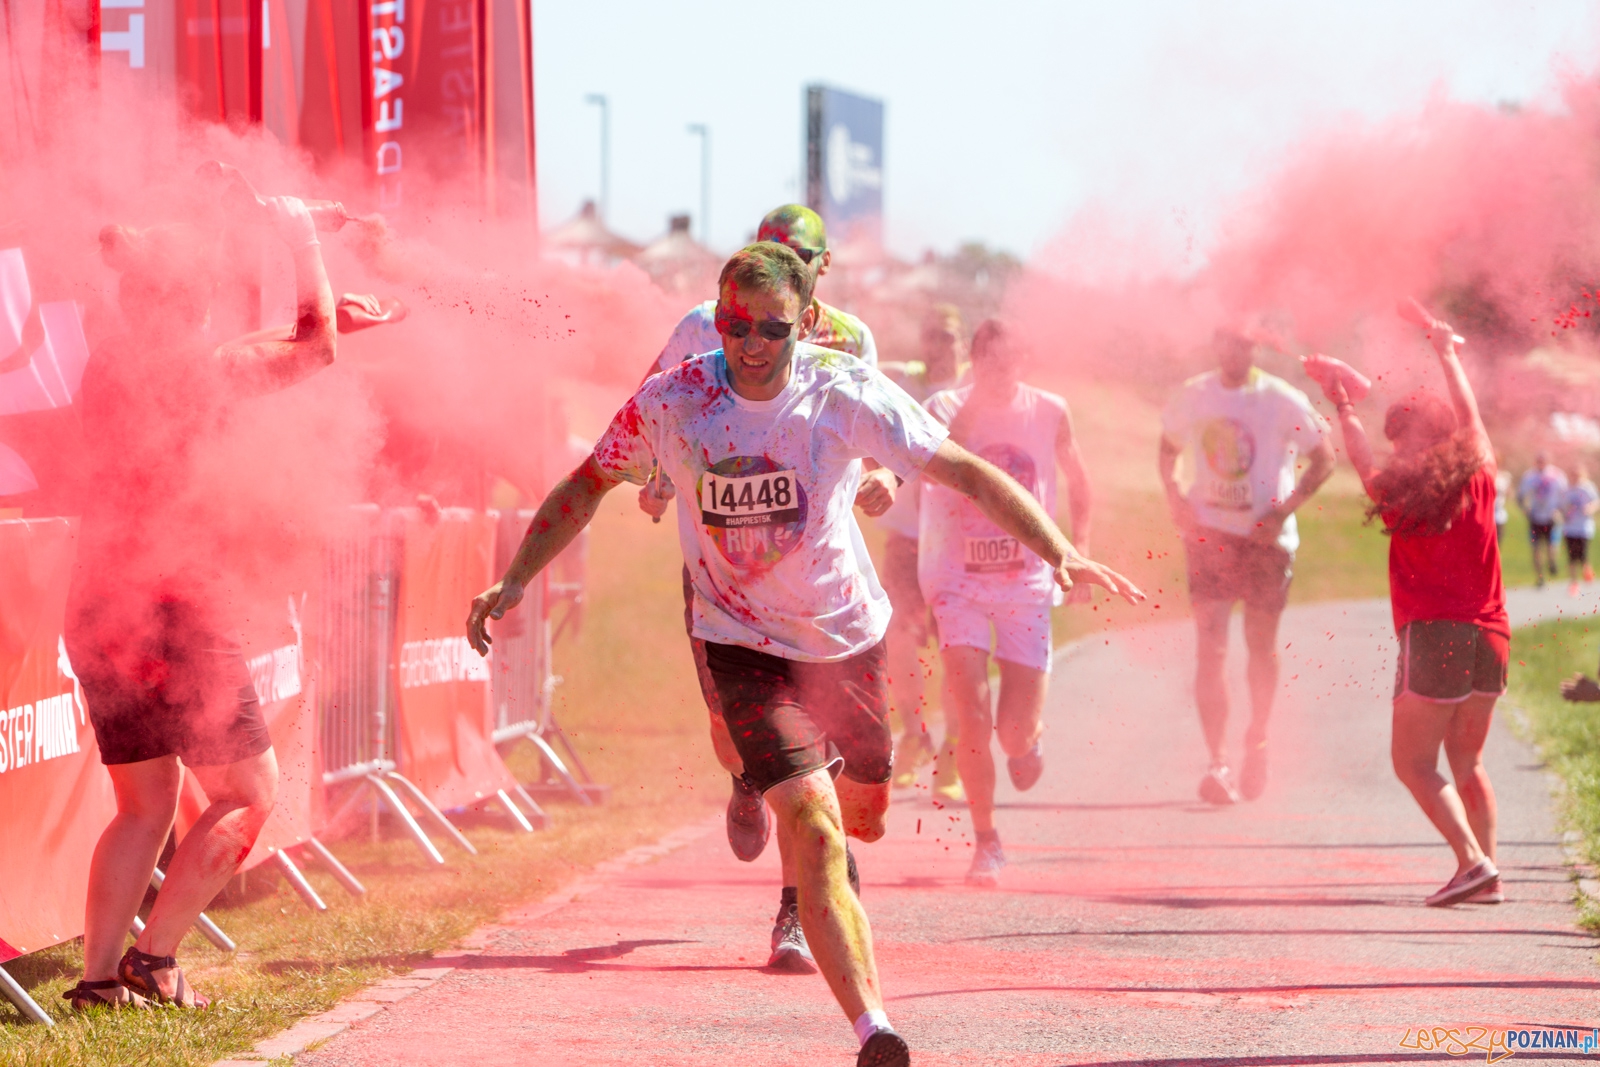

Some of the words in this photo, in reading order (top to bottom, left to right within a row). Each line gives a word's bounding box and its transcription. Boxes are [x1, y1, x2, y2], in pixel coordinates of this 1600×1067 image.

[709, 476, 791, 512] 14448
[725, 514, 772, 526] #HAPPIEST5K
[726, 527, 769, 553] RUN
[969, 538, 1020, 562] 10057
